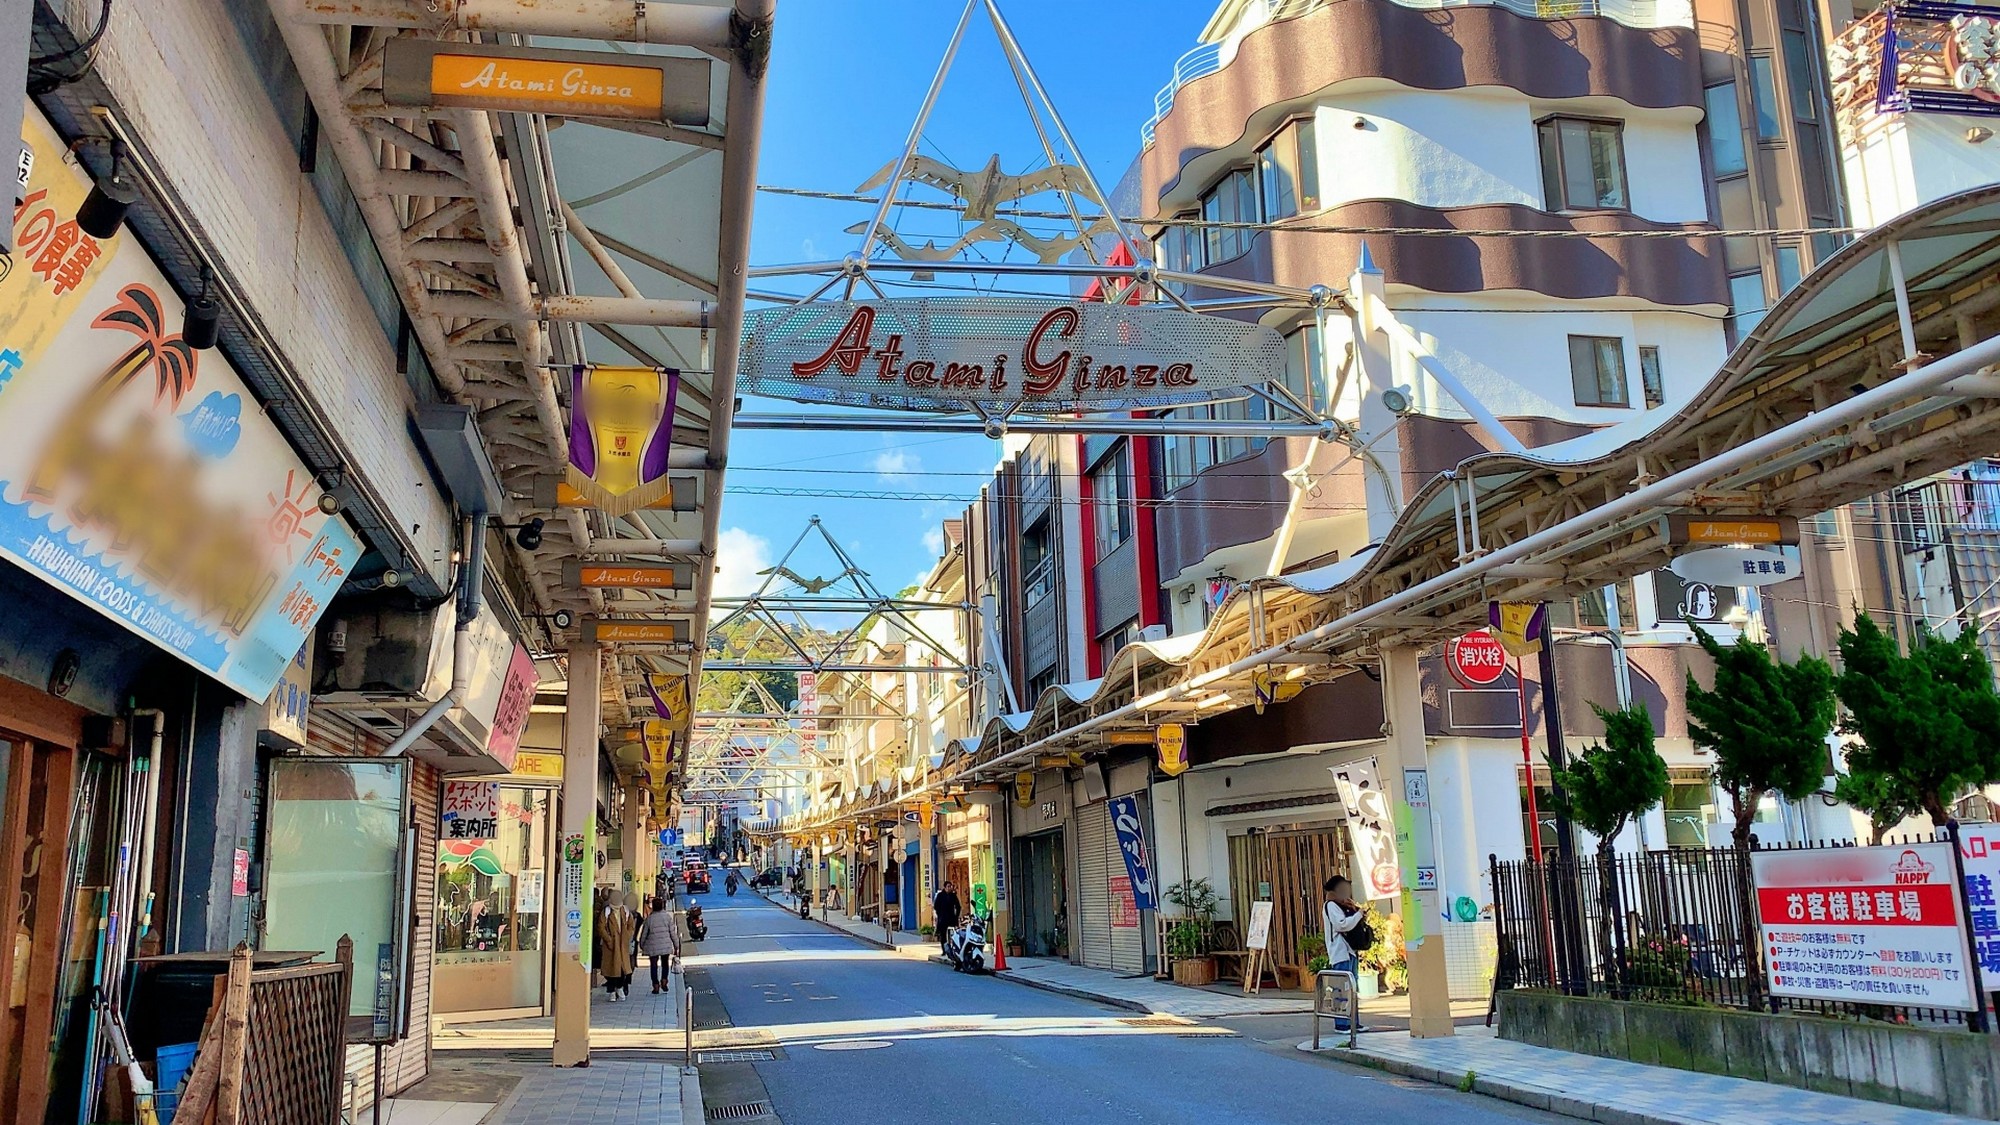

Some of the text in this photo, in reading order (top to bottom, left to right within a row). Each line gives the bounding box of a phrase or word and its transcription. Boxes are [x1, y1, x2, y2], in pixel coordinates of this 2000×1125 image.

[460, 62, 633, 97] Atami Ginza
[792, 305, 1199, 396] Atami Ginza
[1701, 524, 1769, 538] Atami Ginza
[1743, 560, 1786, 575] 駐車場
[593, 570, 662, 583] Atami Ginza
[26, 534, 99, 593] HAWAIIAN
[92, 574, 138, 616] FOODS
[131, 601, 147, 622] &
[140, 606, 176, 643] DARTS
[169, 625, 196, 652] PLAY
[607, 626, 664, 639] Atami Ginza
[1462, 636, 1473, 644] FIRE
[1460, 646, 1502, 667] 消火栓
[457, 782, 492, 798] ナイト
[446, 796, 496, 812] スポット
[449, 818, 497, 838] 案内所
[1896, 872, 1930, 885] HAPPY
[1786, 890, 1922, 922] お客様駐車場
